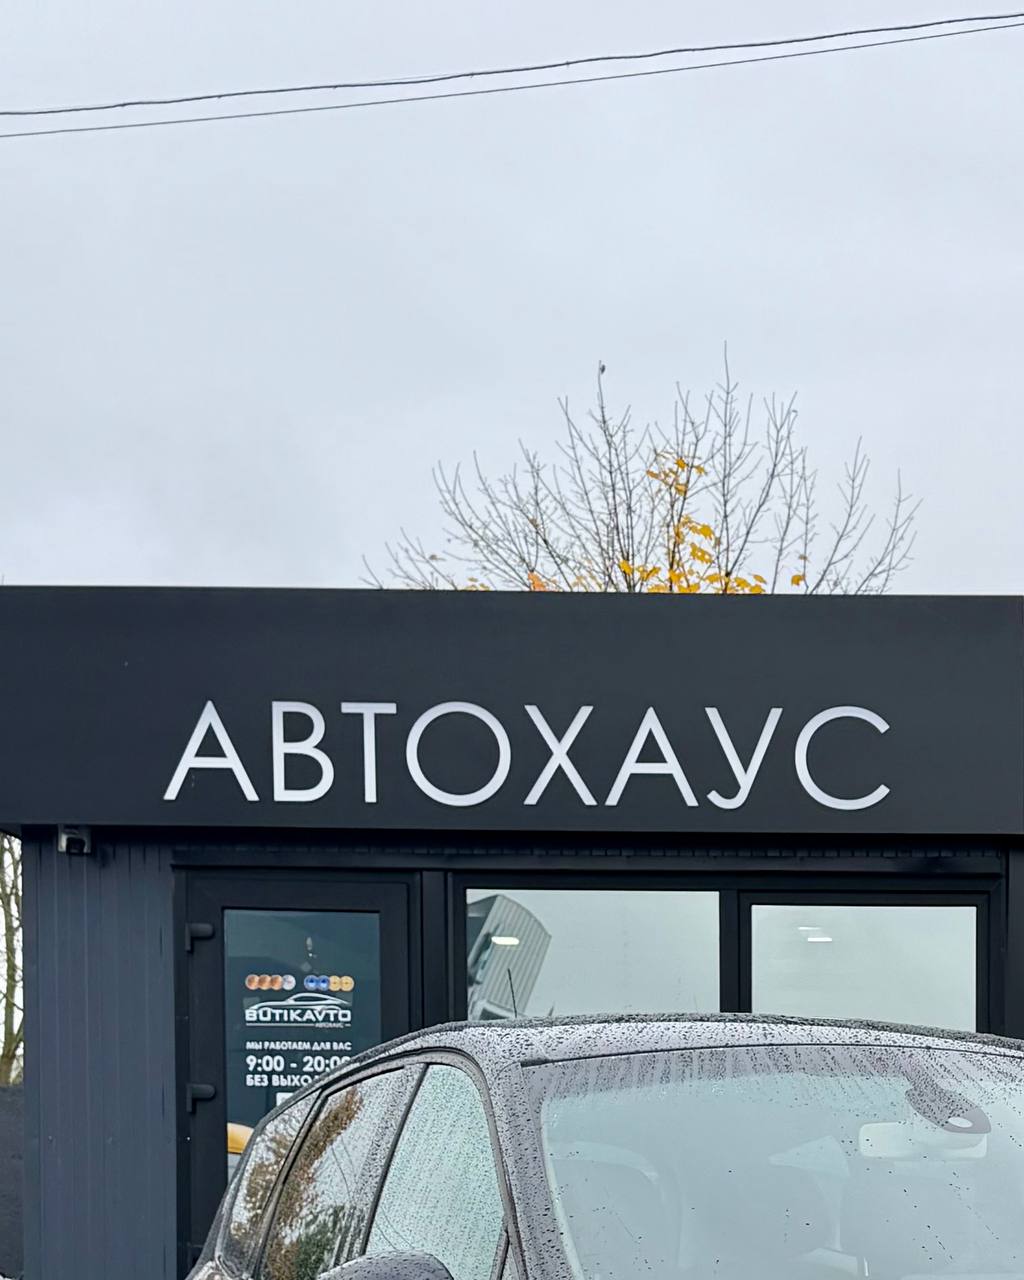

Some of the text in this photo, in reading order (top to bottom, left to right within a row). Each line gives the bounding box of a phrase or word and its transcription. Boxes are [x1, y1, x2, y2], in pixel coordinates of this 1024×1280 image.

[163, 700, 890, 811] АВТОХАУС
[245, 1009, 352, 1021] BUTIKAVTO
[246, 1041, 352, 1050] МЫ РАБОТАЕМ ДЛЯ ВАС
[246, 1055, 285, 1072] 9:00
[246, 1074, 269, 1087] БЕЗ
